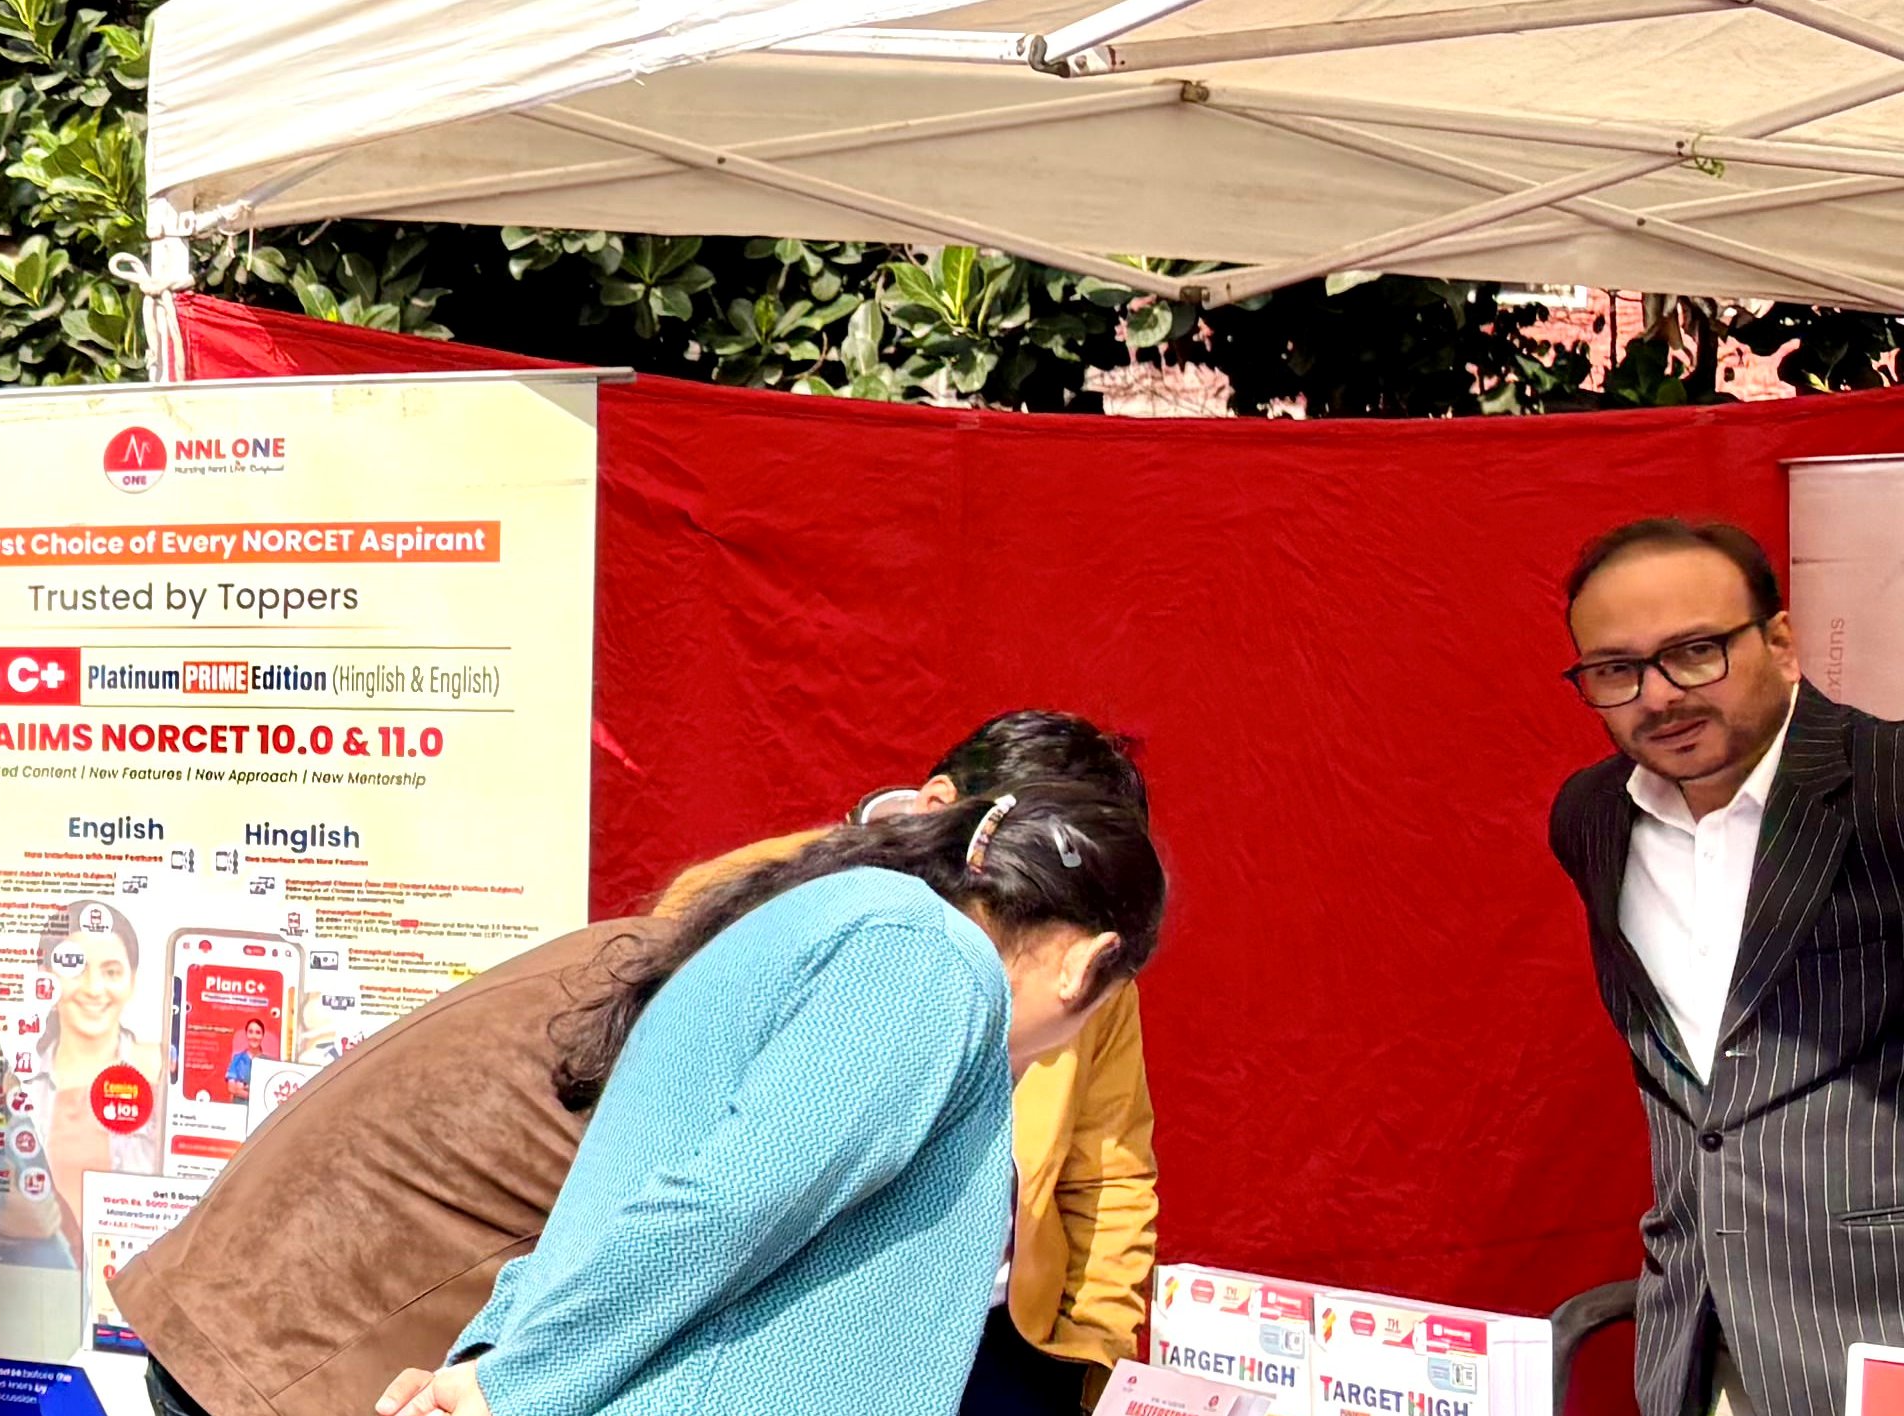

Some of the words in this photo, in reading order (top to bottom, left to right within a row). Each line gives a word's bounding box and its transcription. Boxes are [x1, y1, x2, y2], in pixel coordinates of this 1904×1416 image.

[175, 438, 227, 461] NNL
[231, 437, 286, 458] ONE
[122, 475, 147, 486] ONE
[31, 532, 124, 556] Choice
[129, 531, 156, 554] of
[162, 531, 237, 560] Every
[242, 529, 354, 553] NORCET
[360, 526, 486, 559] Aspirant
[28, 582, 153, 612] Trusted
[166, 583, 207, 619] by
[218, 583, 359, 618] Toppers
[7, 656, 66, 693] C+
[88, 664, 180, 690] Platinum
[189, 664, 247, 691] PRIME
[251, 664, 327, 691] Edition
[332, 664, 406, 698] (Hinglish
[410, 666, 424, 693] &
[430, 665, 500, 699] English)
[101, 723, 250, 754] NORCET
[257, 724, 334, 755] 10.0
[342, 726, 371, 757] &
[378, 726, 443, 758] 11.0
[228, 769, 298, 785] Approach
[68, 816, 165, 846] English
[244, 822, 360, 853] Hinglish
[205, 976, 242, 993] Plan
[244, 980, 267, 993] C+
[103, 1080, 139, 1099] Coming
[117, 1103, 139, 1117] iOS
[1159, 1340, 1236, 1376] TARGET
[1239, 1355, 1296, 1388] HIGH
[1320, 1375, 1404, 1413] TARGET
